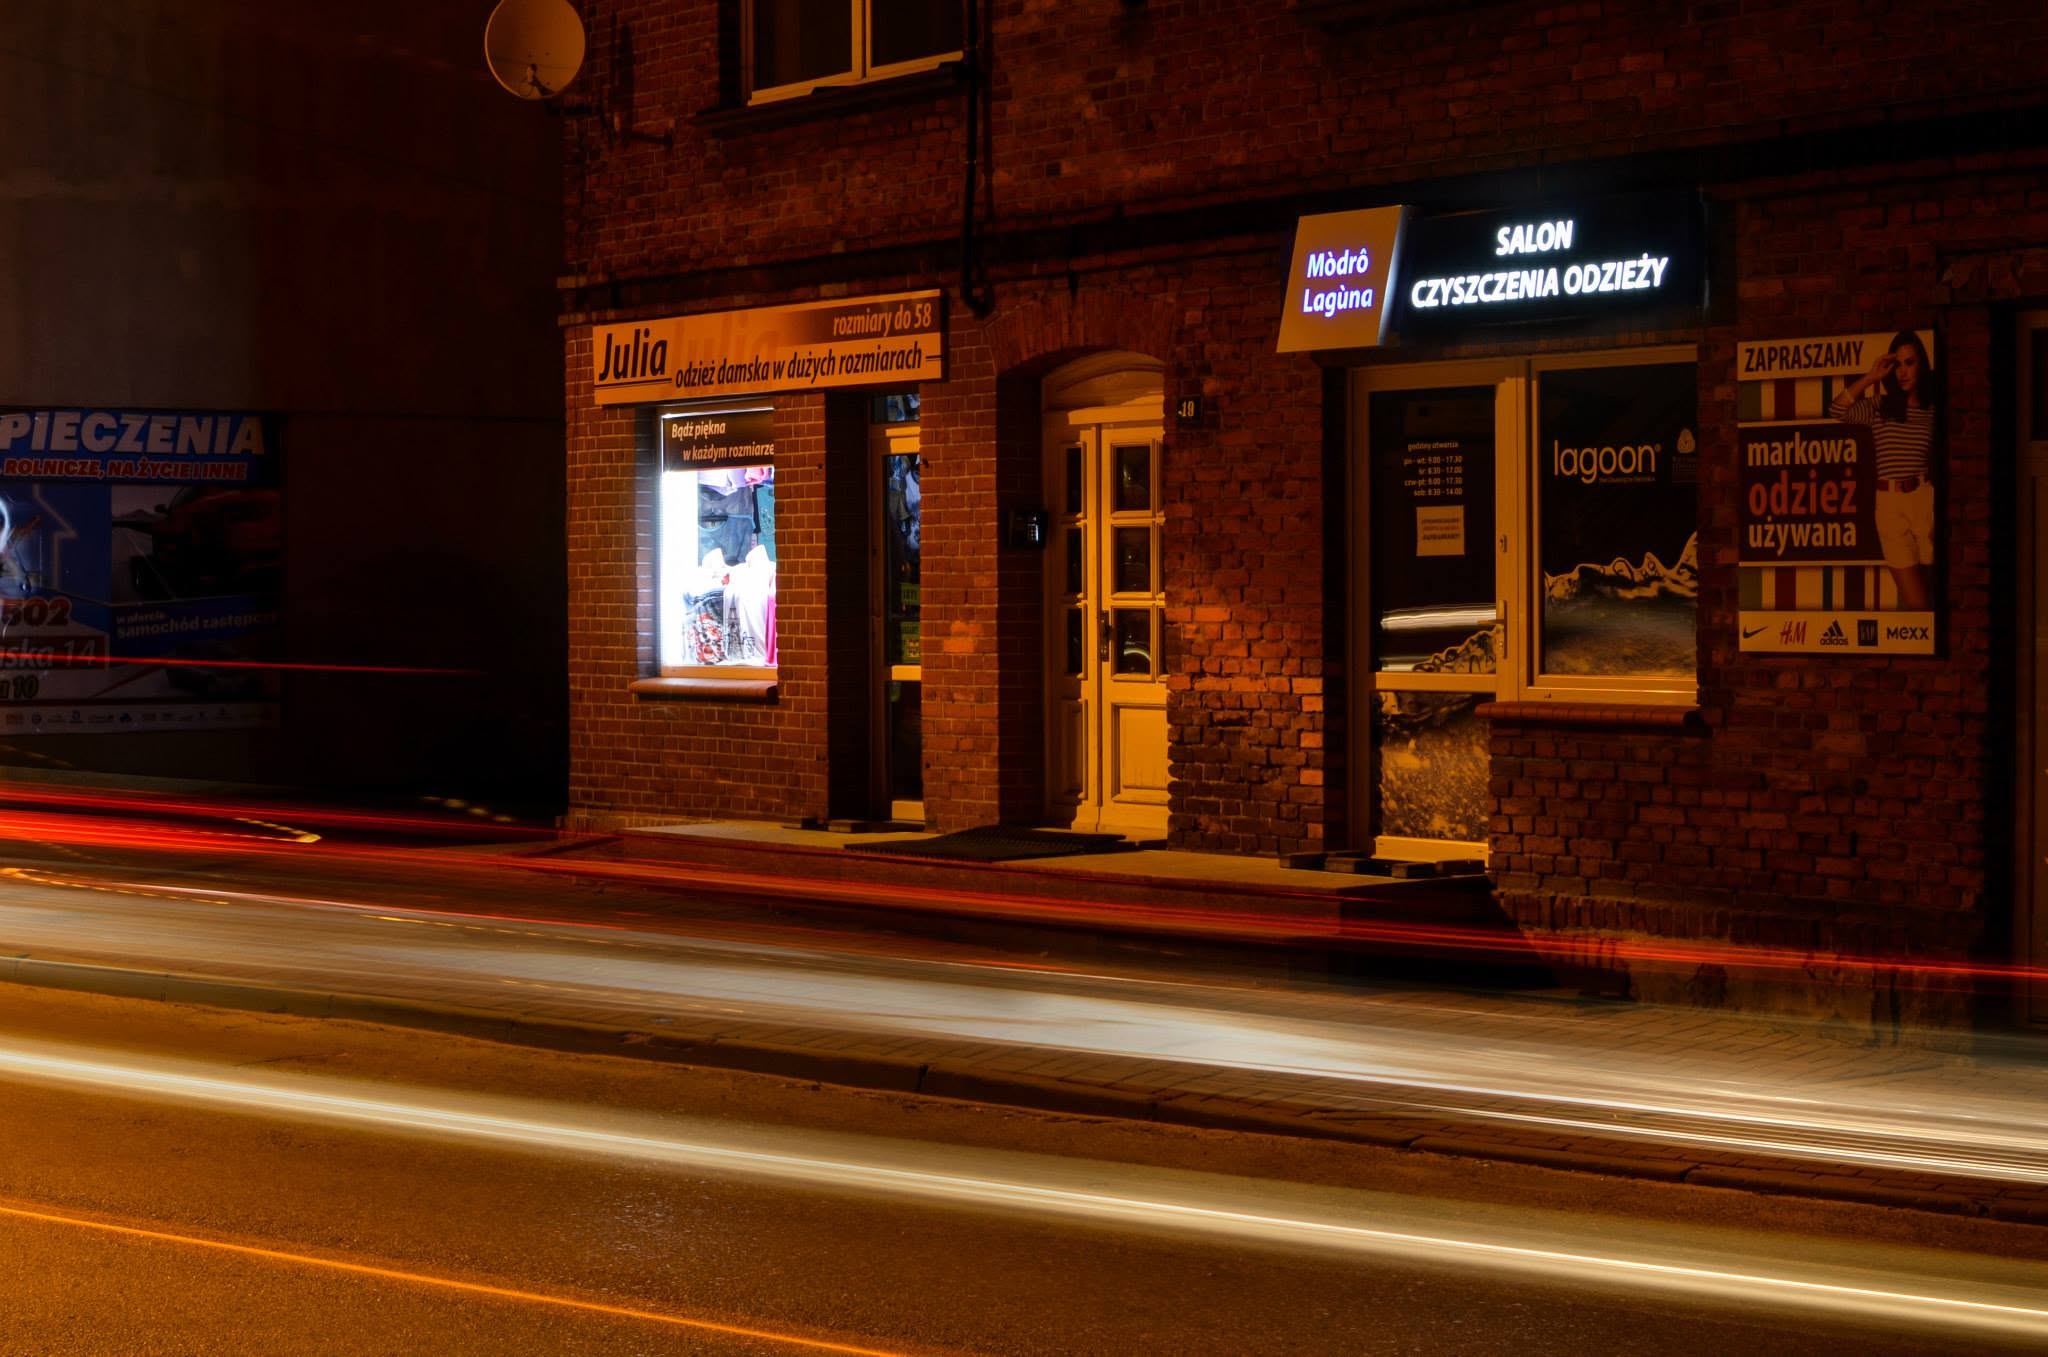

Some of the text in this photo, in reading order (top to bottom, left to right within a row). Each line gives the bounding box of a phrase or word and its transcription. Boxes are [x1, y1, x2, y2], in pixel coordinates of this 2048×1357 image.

[1495, 219, 1574, 256] SALON
[1307, 249, 1369, 279] Mòdrô
[1411, 252, 1669, 309] CZYSZCZENIA ODZIEŻY
[1302, 285, 1374, 318] Lagùna
[833, 303, 932, 337] rozmiary do 58
[599, 328, 668, 381] Julia
[675, 342, 922, 389] odzież damska w dużych rozmiarach
[1744, 341, 1864, 373] ZAPRASZAMY
[671, 420, 726, 442] Bądź piękna
[683, 440, 775, 463] w każdym rozmiarze
[1747, 432, 1858, 468] markowa
[107, 460, 137, 477] NA
[1748, 468, 1857, 516] odzież
[1748, 516, 1857, 556] używana
